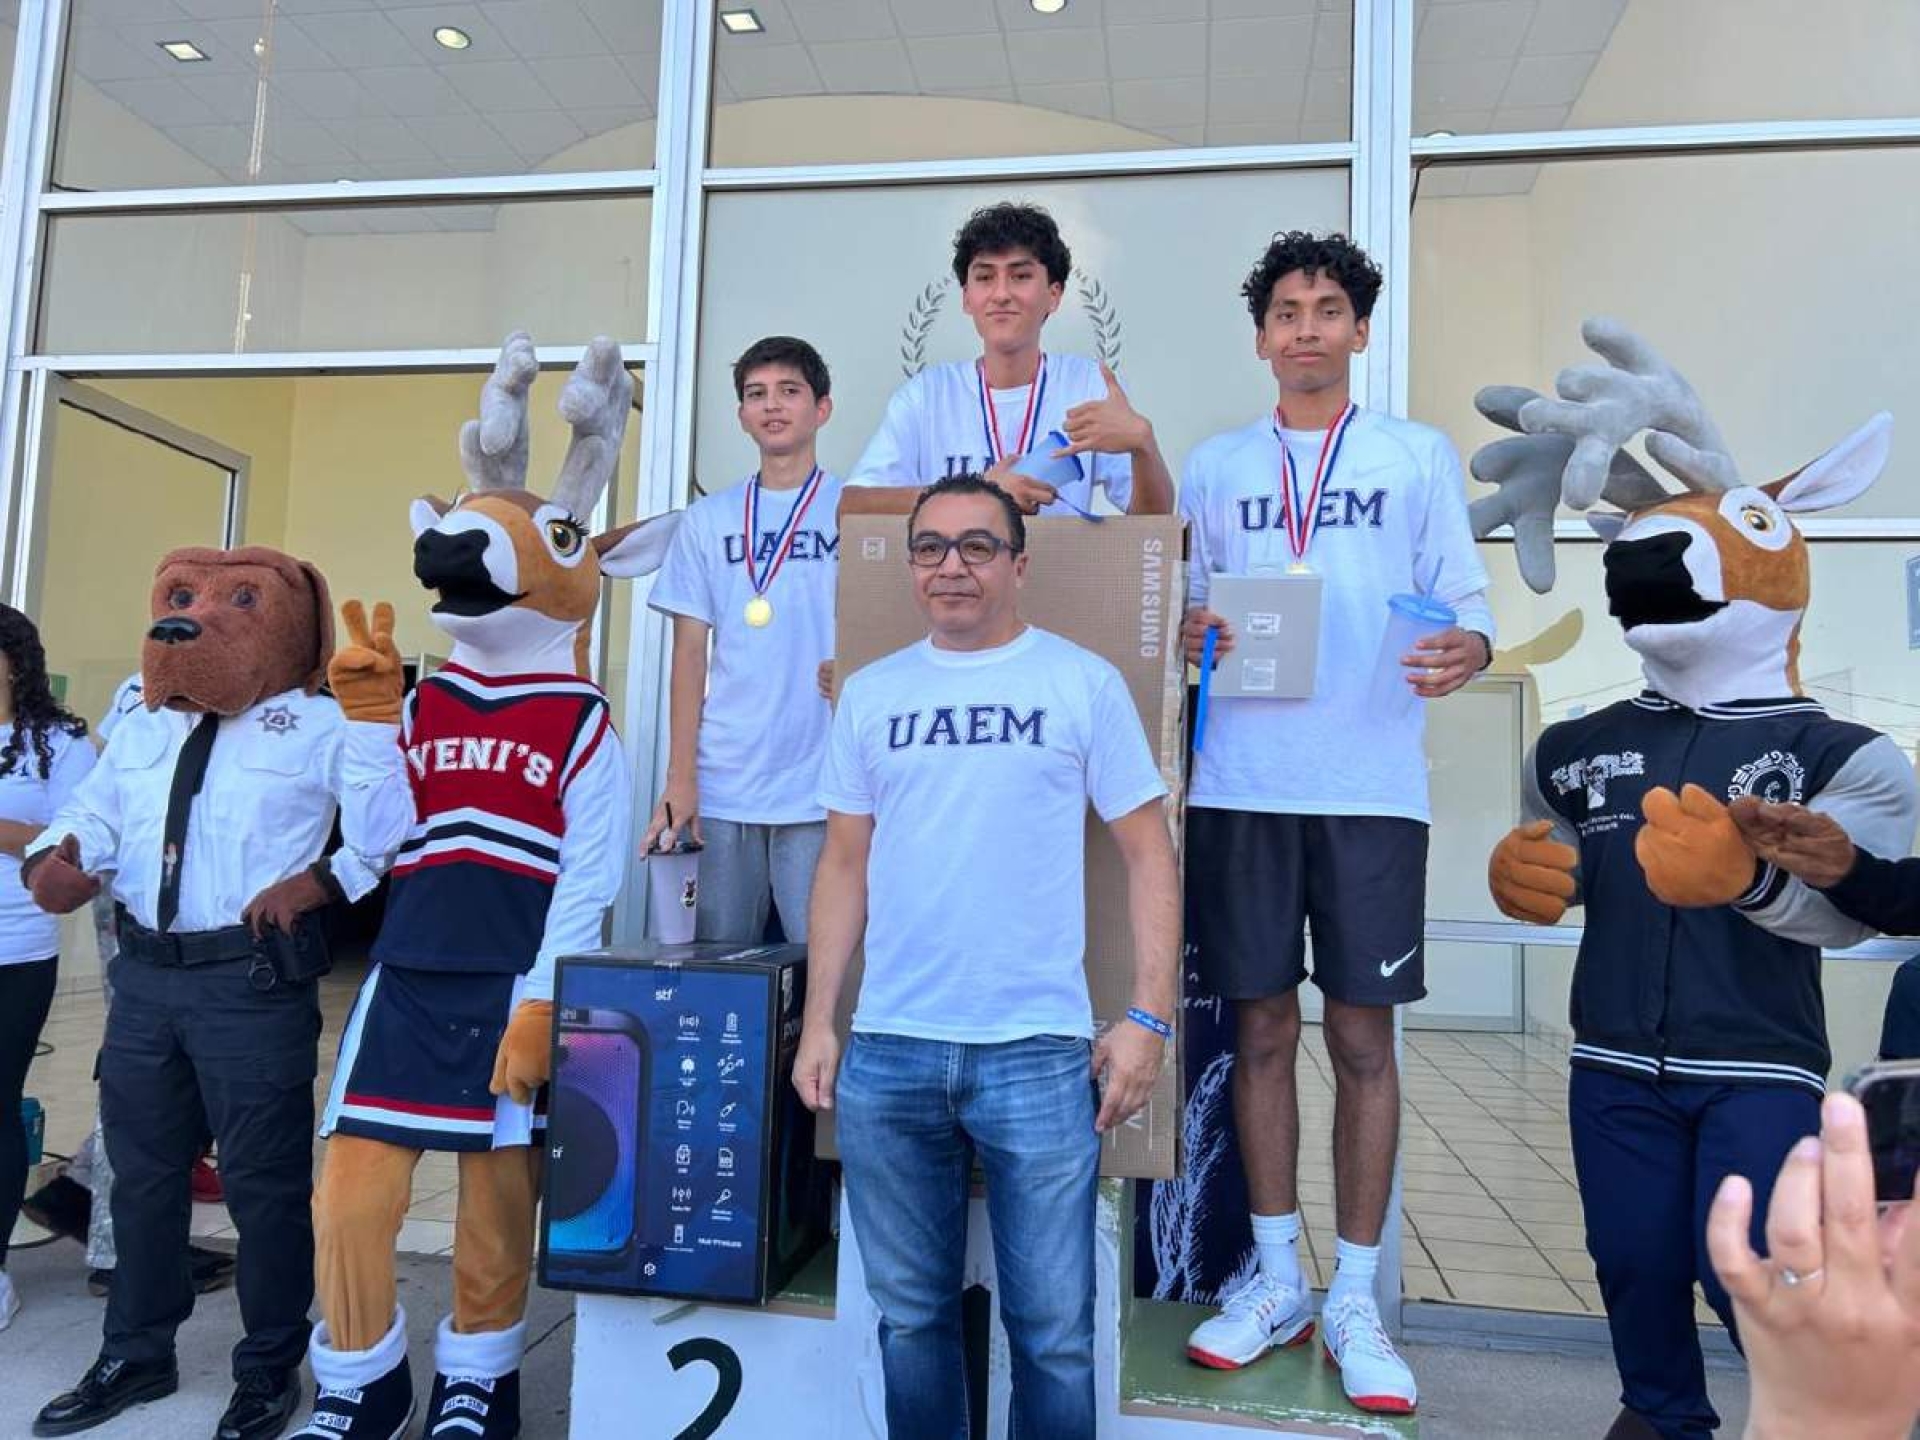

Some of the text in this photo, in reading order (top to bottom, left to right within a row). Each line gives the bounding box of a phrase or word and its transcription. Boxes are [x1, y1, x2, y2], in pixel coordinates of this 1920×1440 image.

[723, 530, 840, 563] UAEM
[1140, 538, 1162, 657] SAMSUNG
[888, 704, 1047, 750] UAEM
[408, 737, 553, 787] VENI'S
[552, 1147, 563, 1159] tf
[667, 1337, 742, 1440] 2
